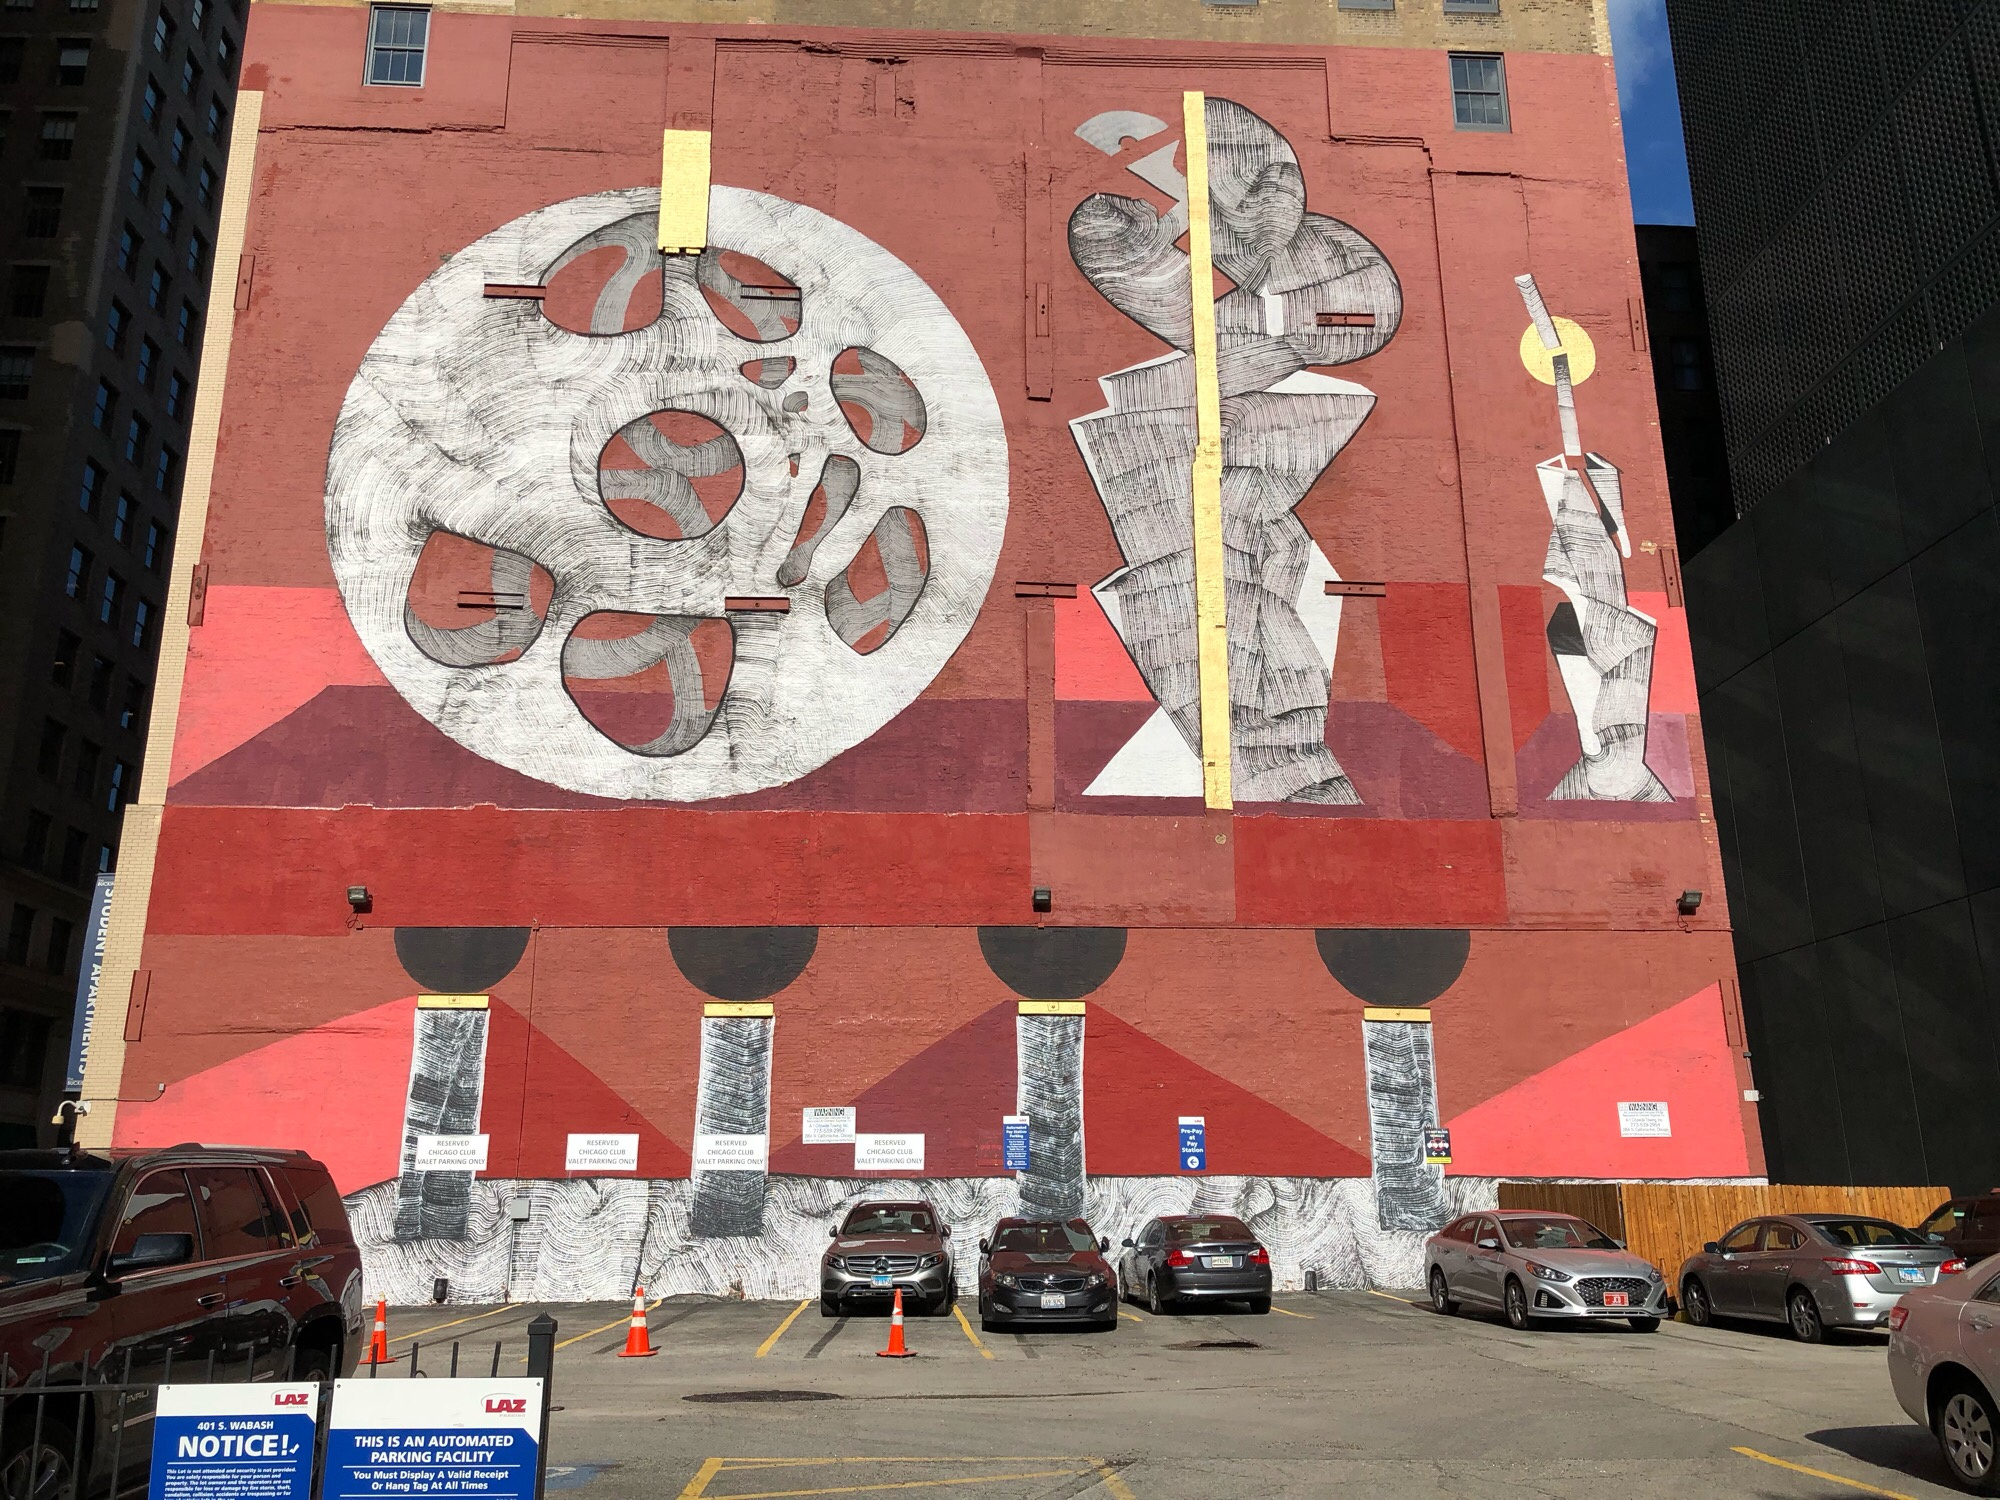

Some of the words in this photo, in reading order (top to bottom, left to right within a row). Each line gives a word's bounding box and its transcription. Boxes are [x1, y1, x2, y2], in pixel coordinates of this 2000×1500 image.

[118, 1389, 149, 1406] ENALI
[275, 1394, 309, 1405] LAZ
[485, 1399, 526, 1413] LAZ
[197, 1422, 215, 1430] 401
[218, 1422, 227, 1430] S.
[230, 1421, 274, 1430] WABASH
[178, 1434, 289, 1457] NOTICE!
[354, 1436, 384, 1447] THIS
[388, 1436, 400, 1447] IS
[404, 1436, 424, 1447] AN
[428, 1436, 514, 1447] AUTOMATED
[371, 1451, 432, 1463] PARKING
[436, 1451, 495, 1462] FACILITY
[354, 1471, 371, 1479] You
[374, 1471, 398, 1479] Must
[400, 1471, 435, 1481] Display
[448, 1470, 471, 1479] Valid
[473, 1470, 509, 1480] Receipt
[372, 1482, 383, 1490] Or
[385, 1482, 410, 1492] Hang
[412, 1482, 428, 1491] Tag
[431, 1482, 442, 1490] At
[446, 1482, 458, 1490] All
[460, 1481, 488, 1490] Times
